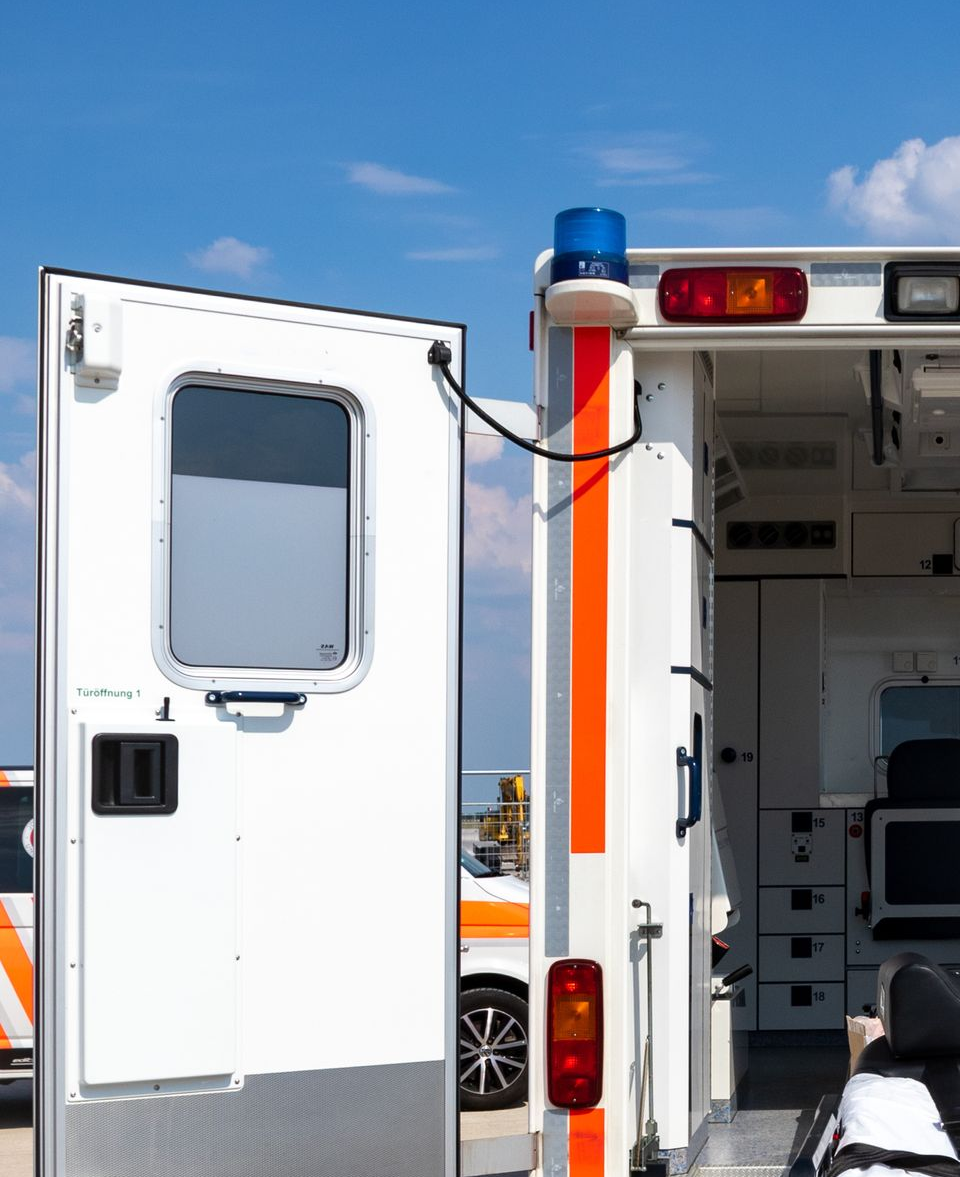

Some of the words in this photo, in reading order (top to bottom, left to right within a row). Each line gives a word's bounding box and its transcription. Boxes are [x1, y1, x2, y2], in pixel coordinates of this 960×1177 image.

[919, 559, 932, 570] 12
[76, 688, 132, 700] Türöffnung
[136, 689, 141, 697] 1
[741, 752, 754, 762] 19
[851, 812, 864, 822] 13
[813, 818, 825, 828] 15
[813, 894, 825, 904] 16
[813, 942, 825, 952] 17
[813, 991, 825, 1001] 18
